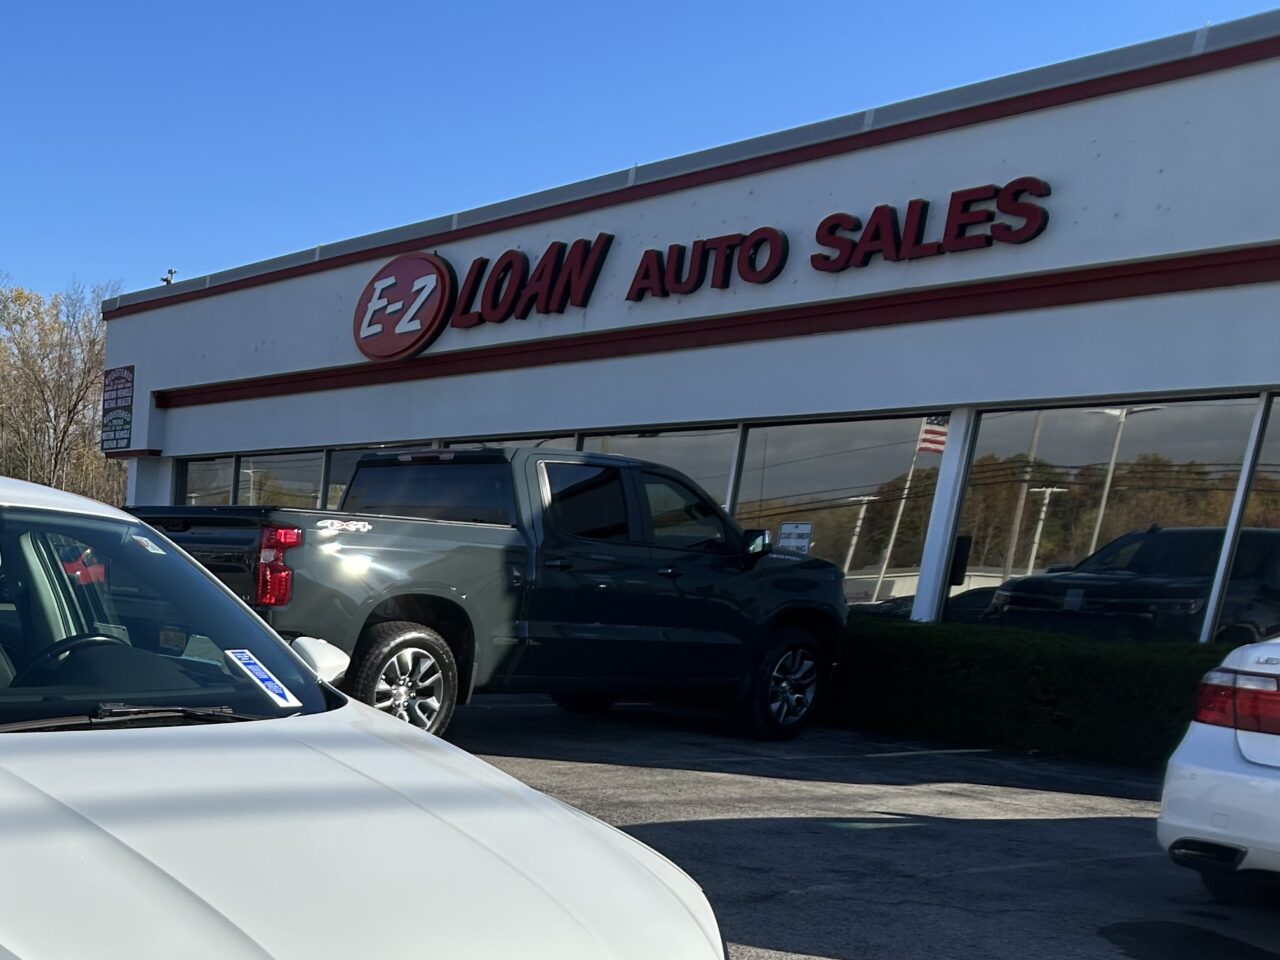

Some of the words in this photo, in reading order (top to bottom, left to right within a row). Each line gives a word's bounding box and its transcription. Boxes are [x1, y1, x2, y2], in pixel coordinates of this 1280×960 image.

[358, 272, 440, 340] E-Z
[449, 231, 616, 330] LOAN
[627, 225, 790, 302] AUTO
[810, 175, 1052, 274] SALES
